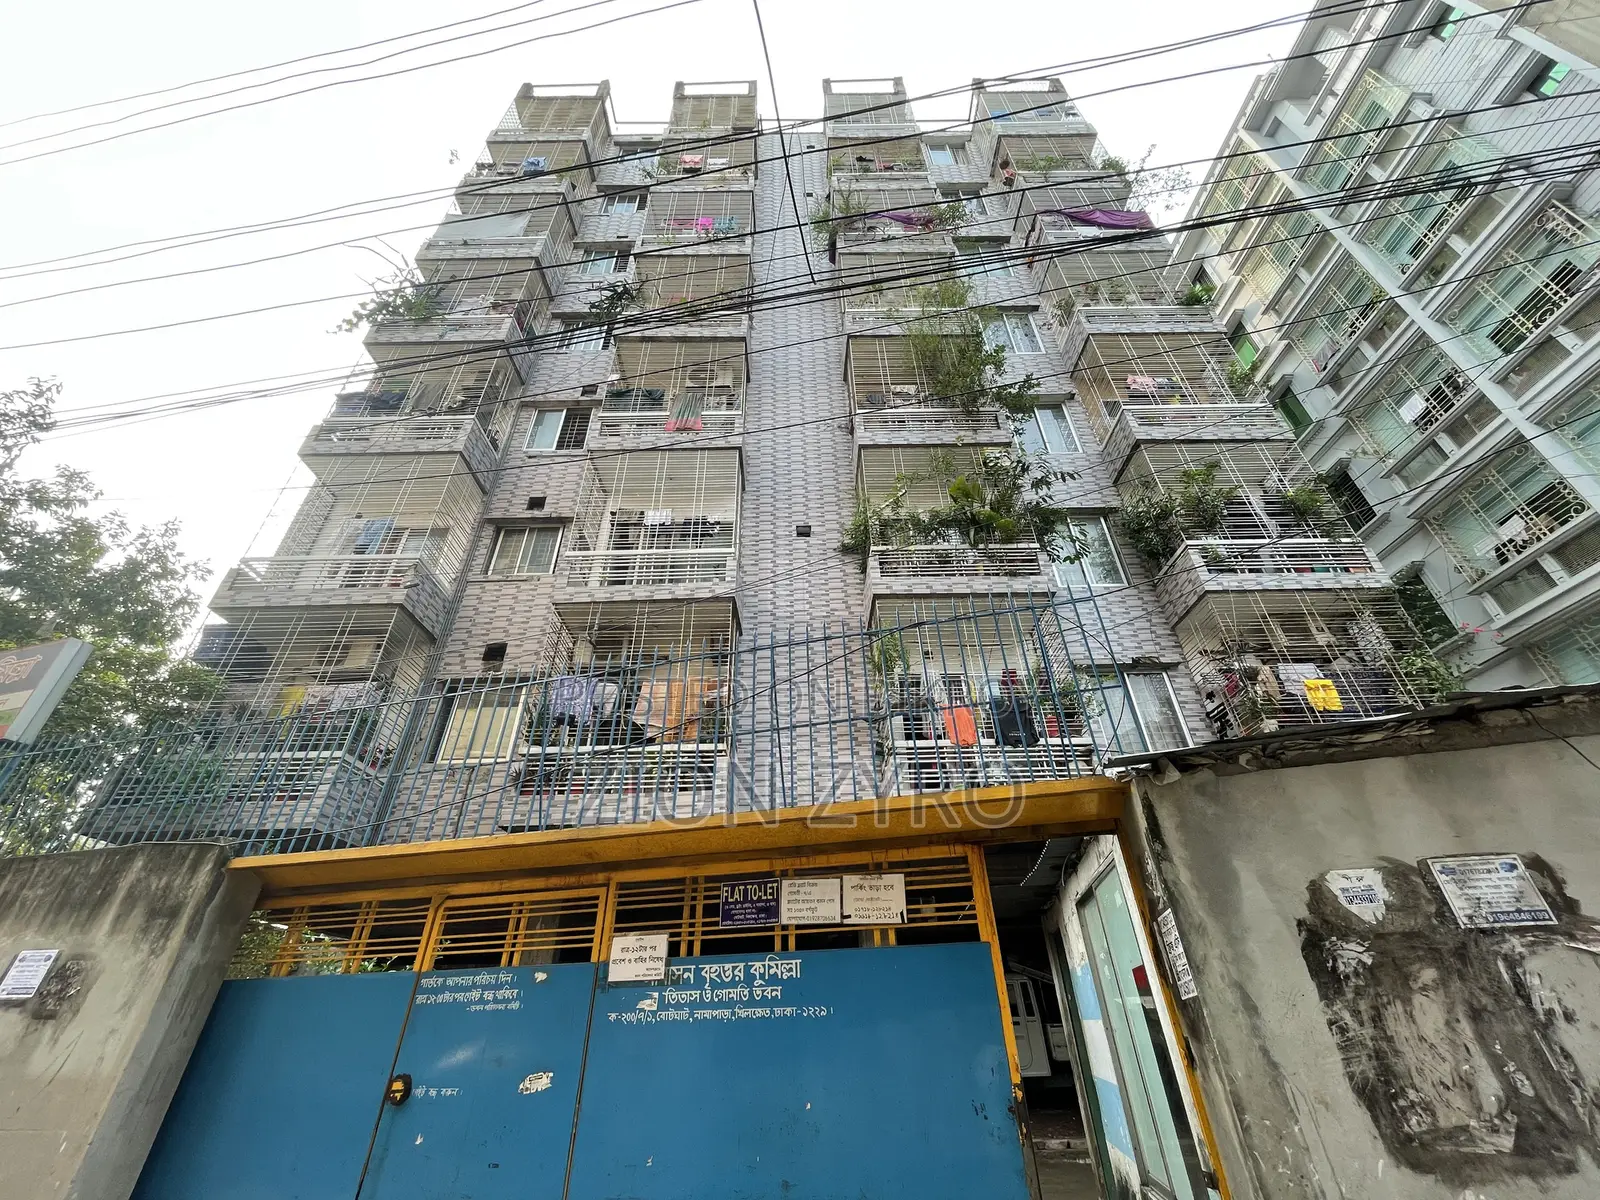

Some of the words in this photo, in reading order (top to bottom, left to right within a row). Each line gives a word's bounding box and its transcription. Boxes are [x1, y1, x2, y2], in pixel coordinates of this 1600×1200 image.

[723, 886, 745, 903] FLAT
[746, 883, 778, 901] TO-LET
[420, 975, 446, 988] গার্ডকে
[446, 975, 474, 988] আপনার
[698, 962, 746, 990] বৃহত্তর
[747, 954, 802, 987] কুমিল্লা
[662, 987, 702, 1005] তিতাস
[713, 983, 750, 1003] গোমতি
[752, 986, 783, 1001] ভবন
